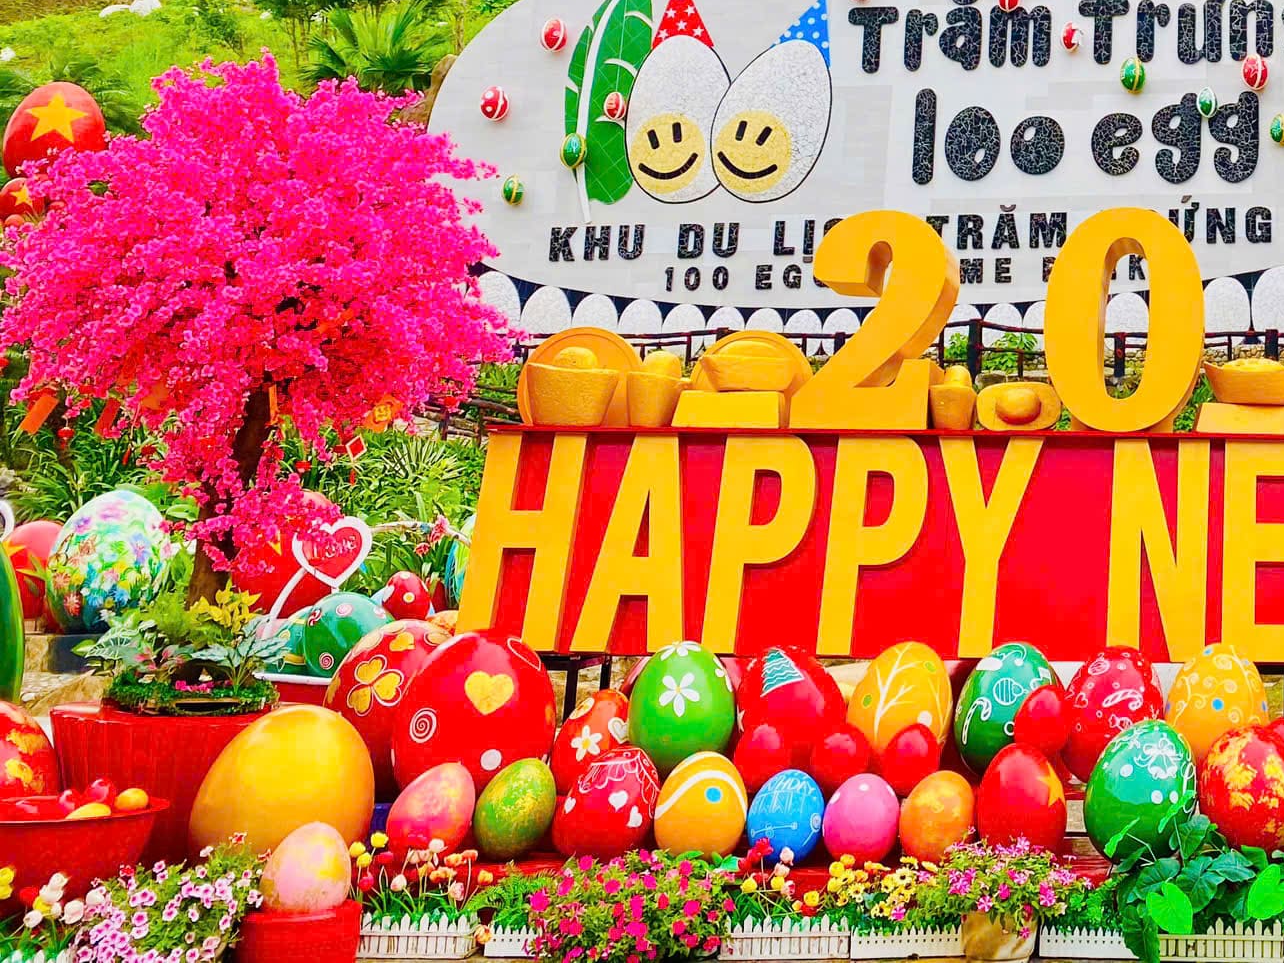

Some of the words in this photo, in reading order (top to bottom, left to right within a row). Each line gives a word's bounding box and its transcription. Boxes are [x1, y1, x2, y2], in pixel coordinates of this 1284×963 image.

[1091, 90, 1260, 184] egg
[548, 223, 646, 262] KHU
[677, 222, 741, 259] DU
[664, 265, 730, 292] 100
[755, 263, 829, 291] EG
[456, 431, 1045, 659] HAPPY
